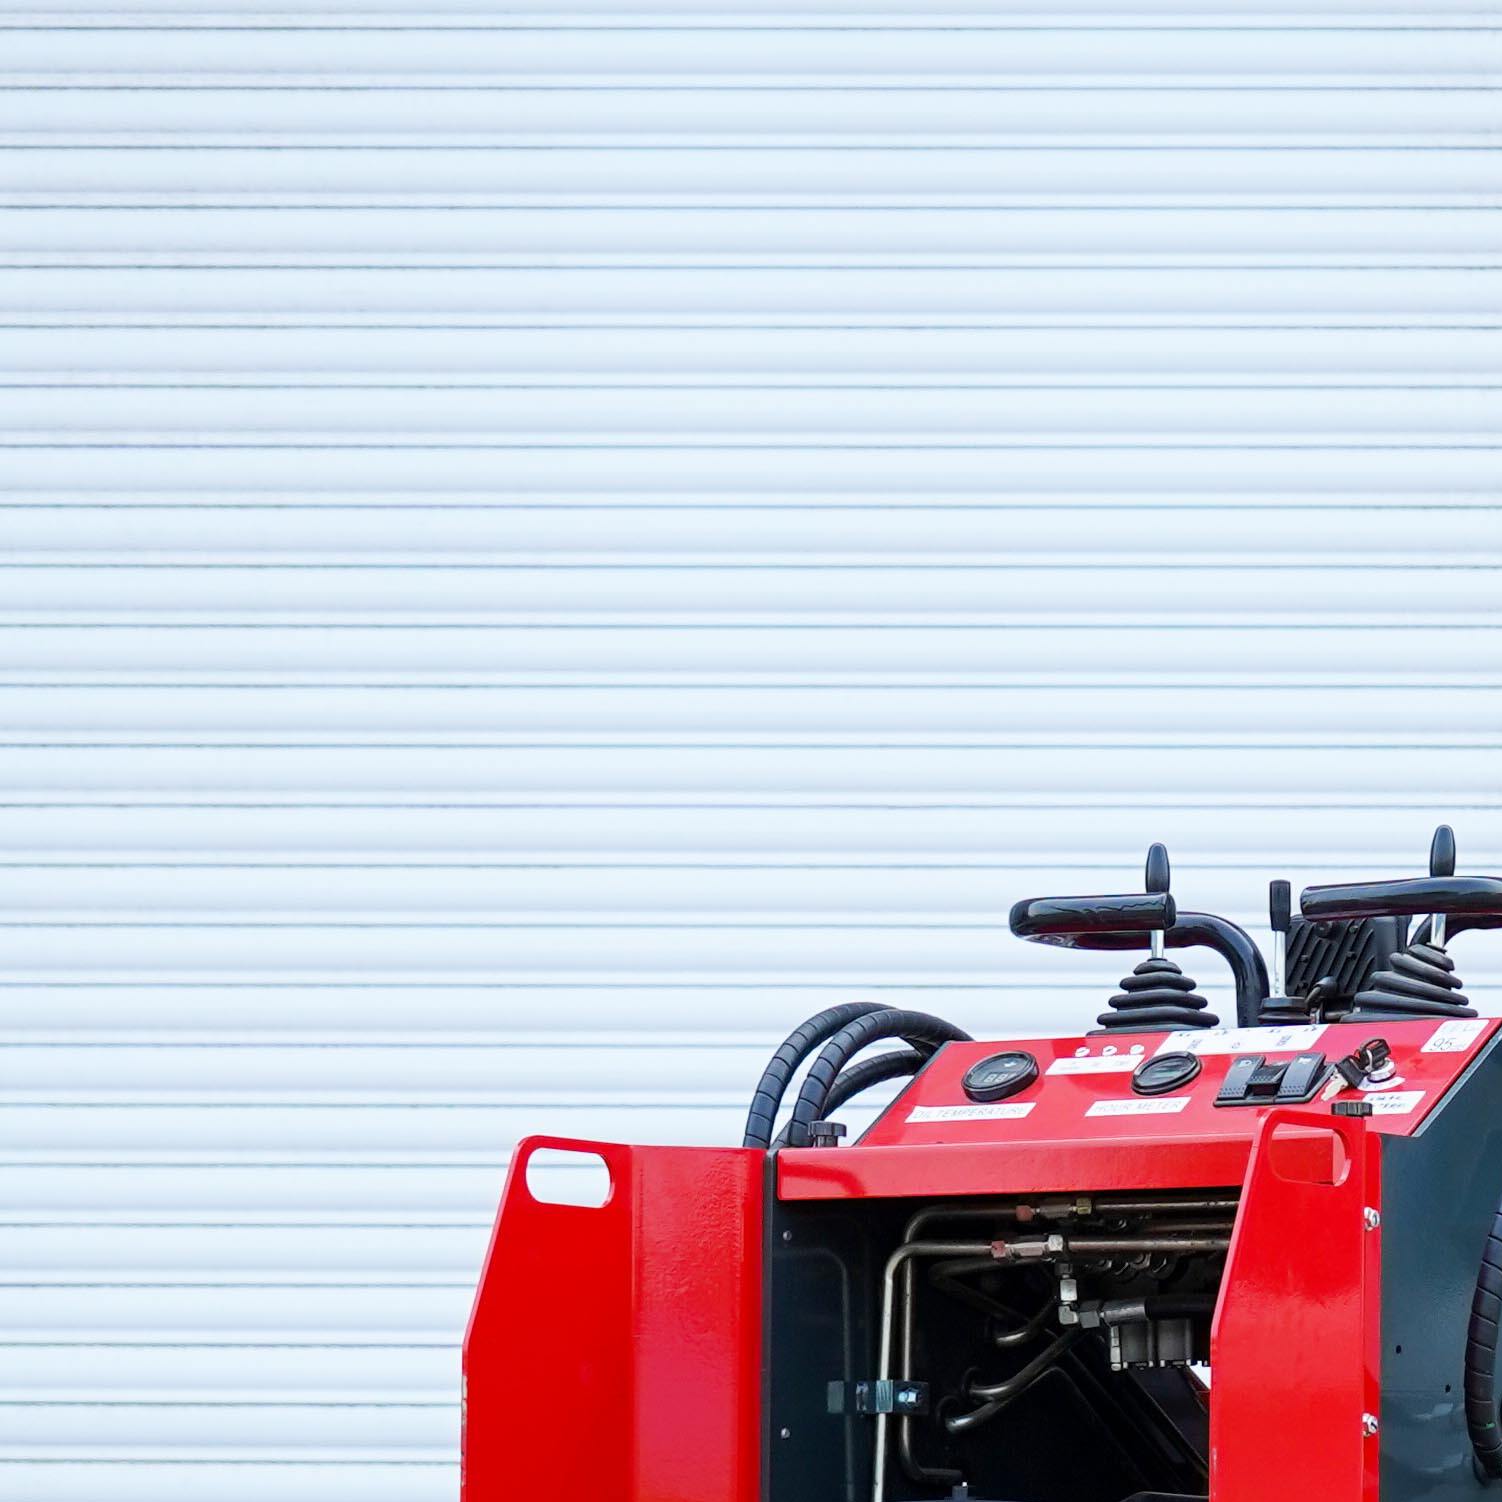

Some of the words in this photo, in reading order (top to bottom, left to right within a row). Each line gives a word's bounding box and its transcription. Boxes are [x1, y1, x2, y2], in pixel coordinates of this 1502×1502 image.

[936, 1105, 1027, 1118] TEMPERATURE
[1093, 1102, 1129, 1112] HOUR
[1136, 1100, 1182, 1110] METER
